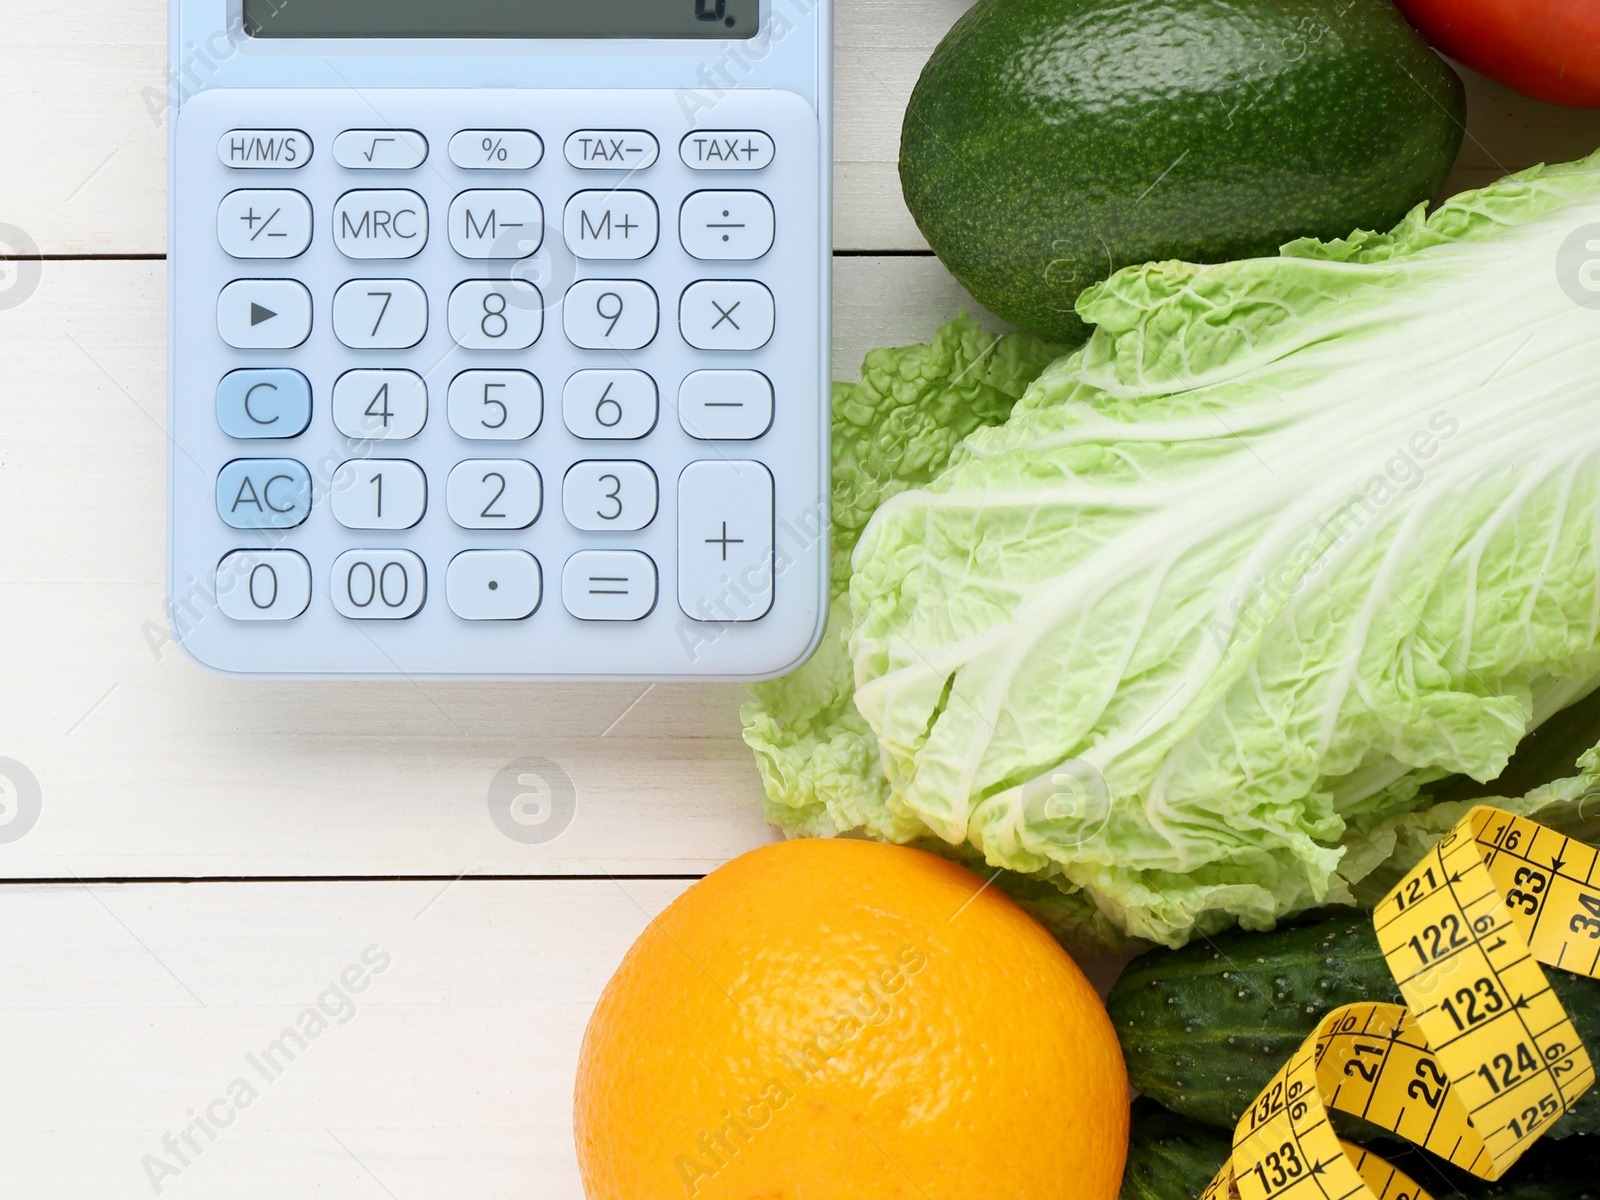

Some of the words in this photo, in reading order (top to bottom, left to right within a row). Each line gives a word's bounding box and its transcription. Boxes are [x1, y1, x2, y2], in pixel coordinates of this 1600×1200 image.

[231, 138, 296, 161] H/M/S
[693, 138, 759, 161] TAX+
[342, 209, 417, 239] MRC
[581, 210, 638, 239] M+
[367, 292, 392, 337] 7
[481, 293, 507, 338] 8
[597, 292, 623, 337] 9
[245, 383, 279, 425] C
[364, 383, 394, 427] 4
[481, 384, 507, 429] 5
[595, 382, 622, 427] 6
[231, 475, 295, 513] AC
[370, 473, 383, 518] 1
[481, 473, 506, 518] 2
[597, 474, 623, 520] 3
[249, 564, 277, 610] 0
[347, 562, 408, 608] 00
[1494, 825, 1521, 851] 16
[1391, 867, 1438, 911] 121
[1505, 867, 1547, 916] 33
[1408, 913, 1469, 965] 122
[1440, 977, 1504, 1032] 123
[1344, 1044, 1385, 1083] 21
[1407, 1058, 1448, 1109] 22
[1478, 1042, 1538, 1094] 124
[1250, 1081, 1283, 1130] 132
[1507, 1093, 1559, 1140] 125
[1254, 1142, 1303, 1195] 133
